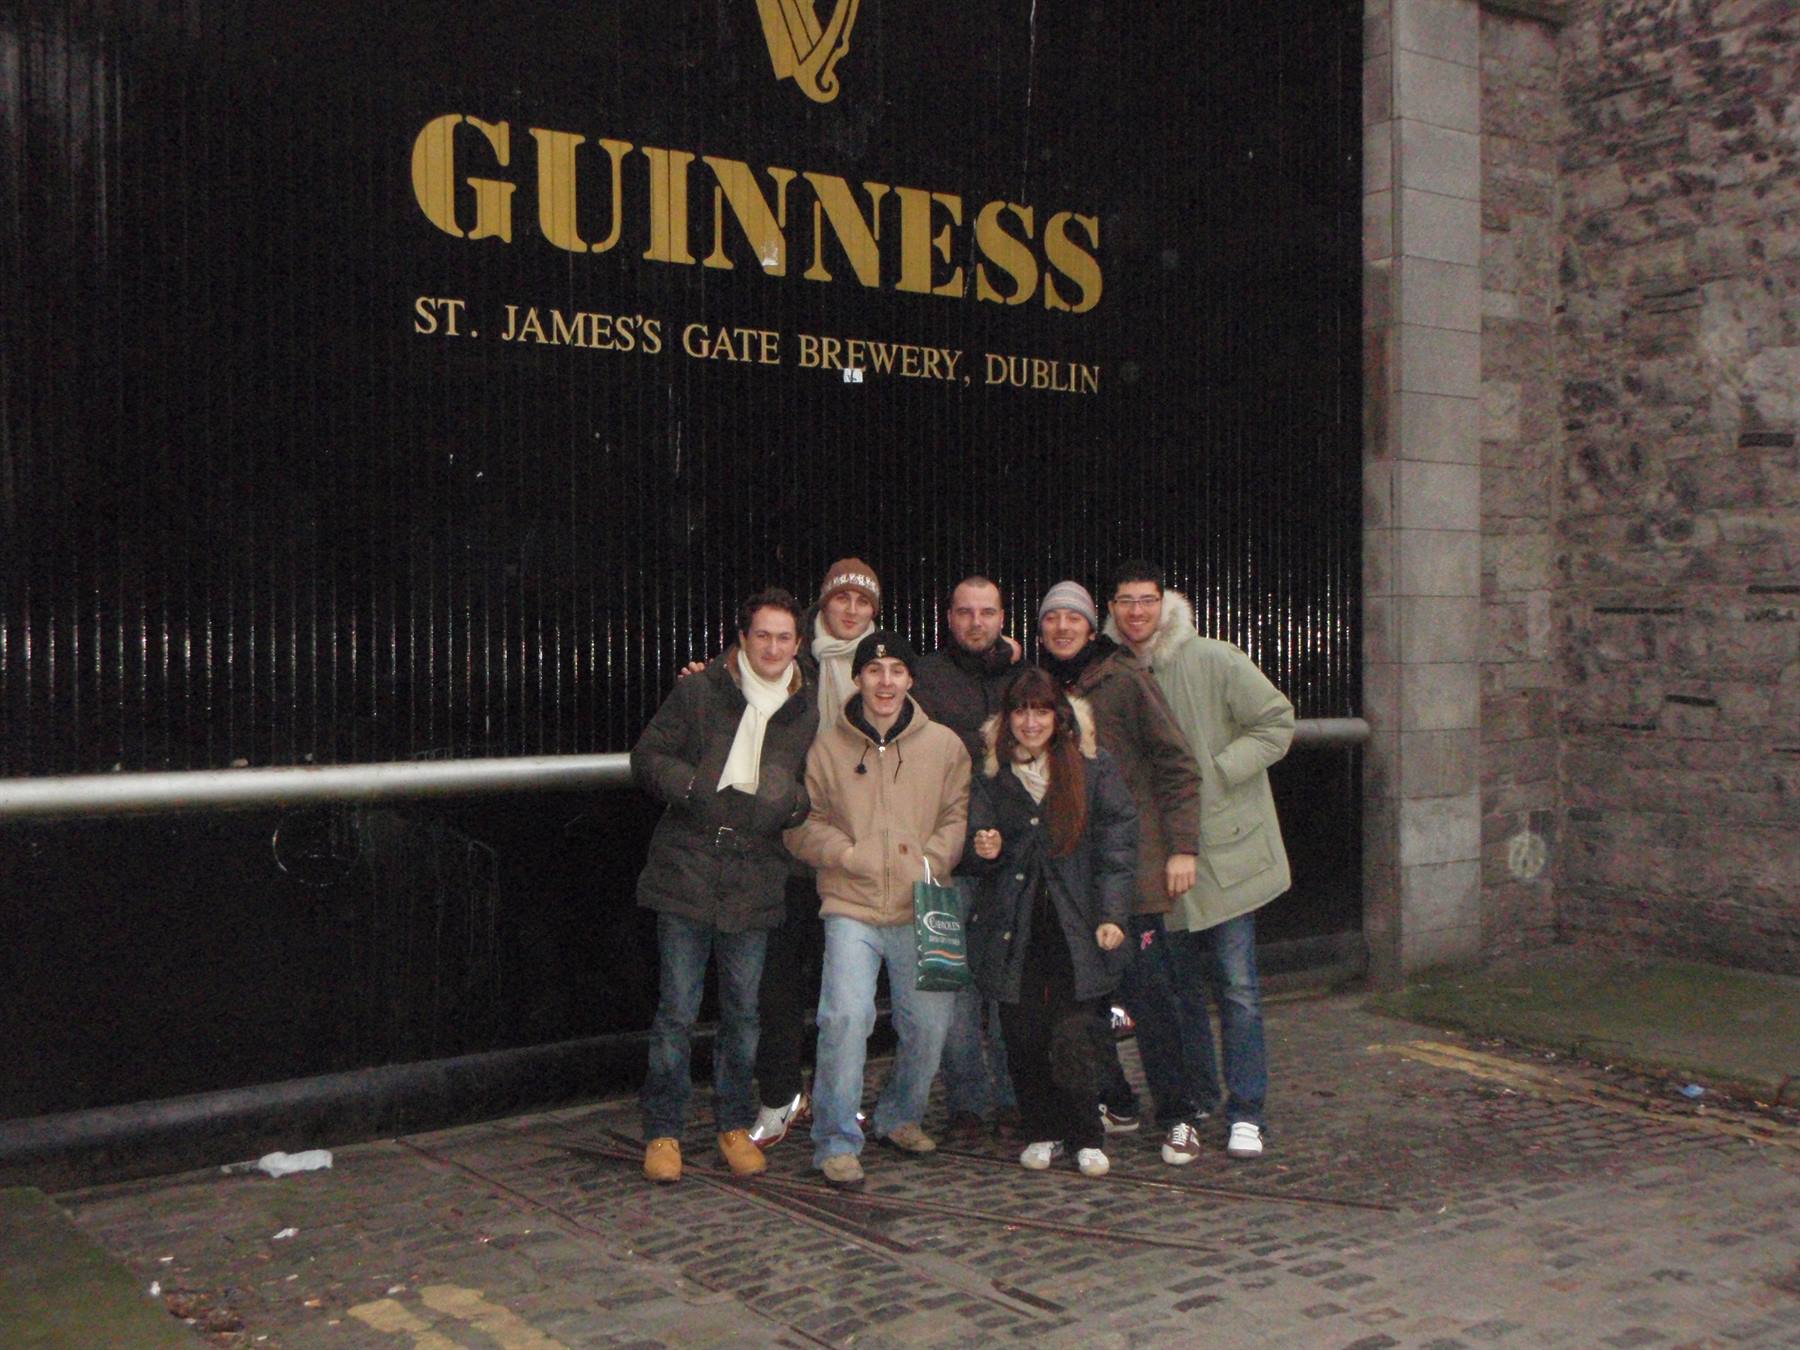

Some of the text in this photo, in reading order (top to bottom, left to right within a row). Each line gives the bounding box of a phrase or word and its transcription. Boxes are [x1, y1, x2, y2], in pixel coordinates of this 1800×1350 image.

[410, 113, 1103, 313] GUINNESS
[415, 296, 1100, 394] ST. JAMES'S GATE BREWERY, DUBLIN
